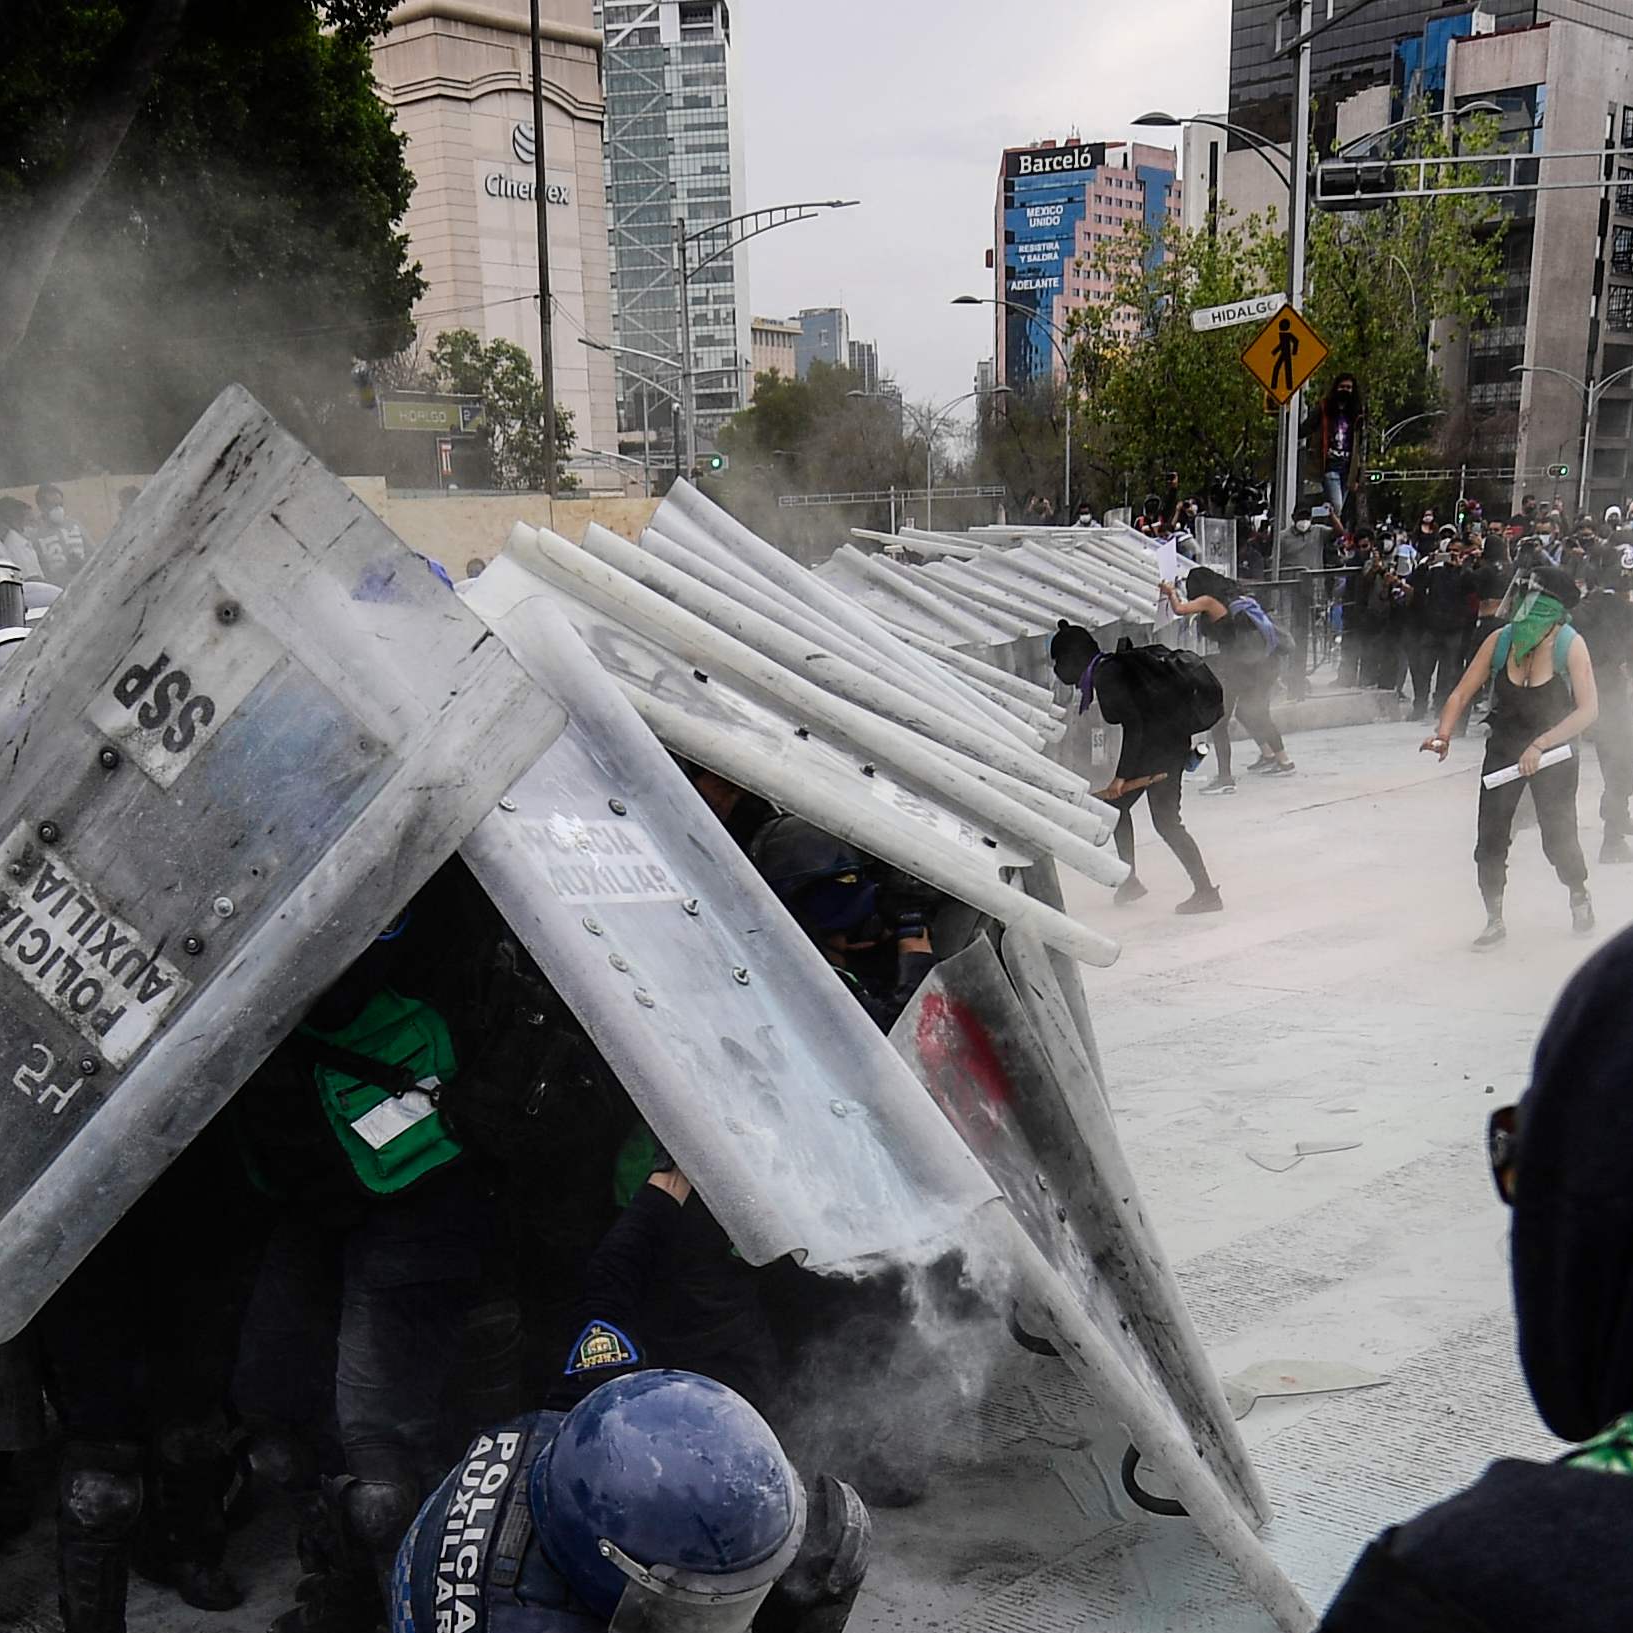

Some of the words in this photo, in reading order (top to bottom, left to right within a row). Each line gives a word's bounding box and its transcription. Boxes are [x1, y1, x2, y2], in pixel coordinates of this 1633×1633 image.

[1019, 147, 1092, 175] Barceló
[485, 173, 569, 206] Cineex
[1029, 215, 1061, 228] UNIDO
[1020, 255, 1026, 264] Y
[1010, 276, 1060, 292] ADELANTE
[1211, 301, 1278, 324] HIDALGO
[463, 409, 472, 421] 2
[113, 648, 215, 754] SSP
[519, 824, 644, 855] POCIA
[548, 864, 677, 896] AUXILIAR
[15, 845, 173, 1005] AUXILIA
